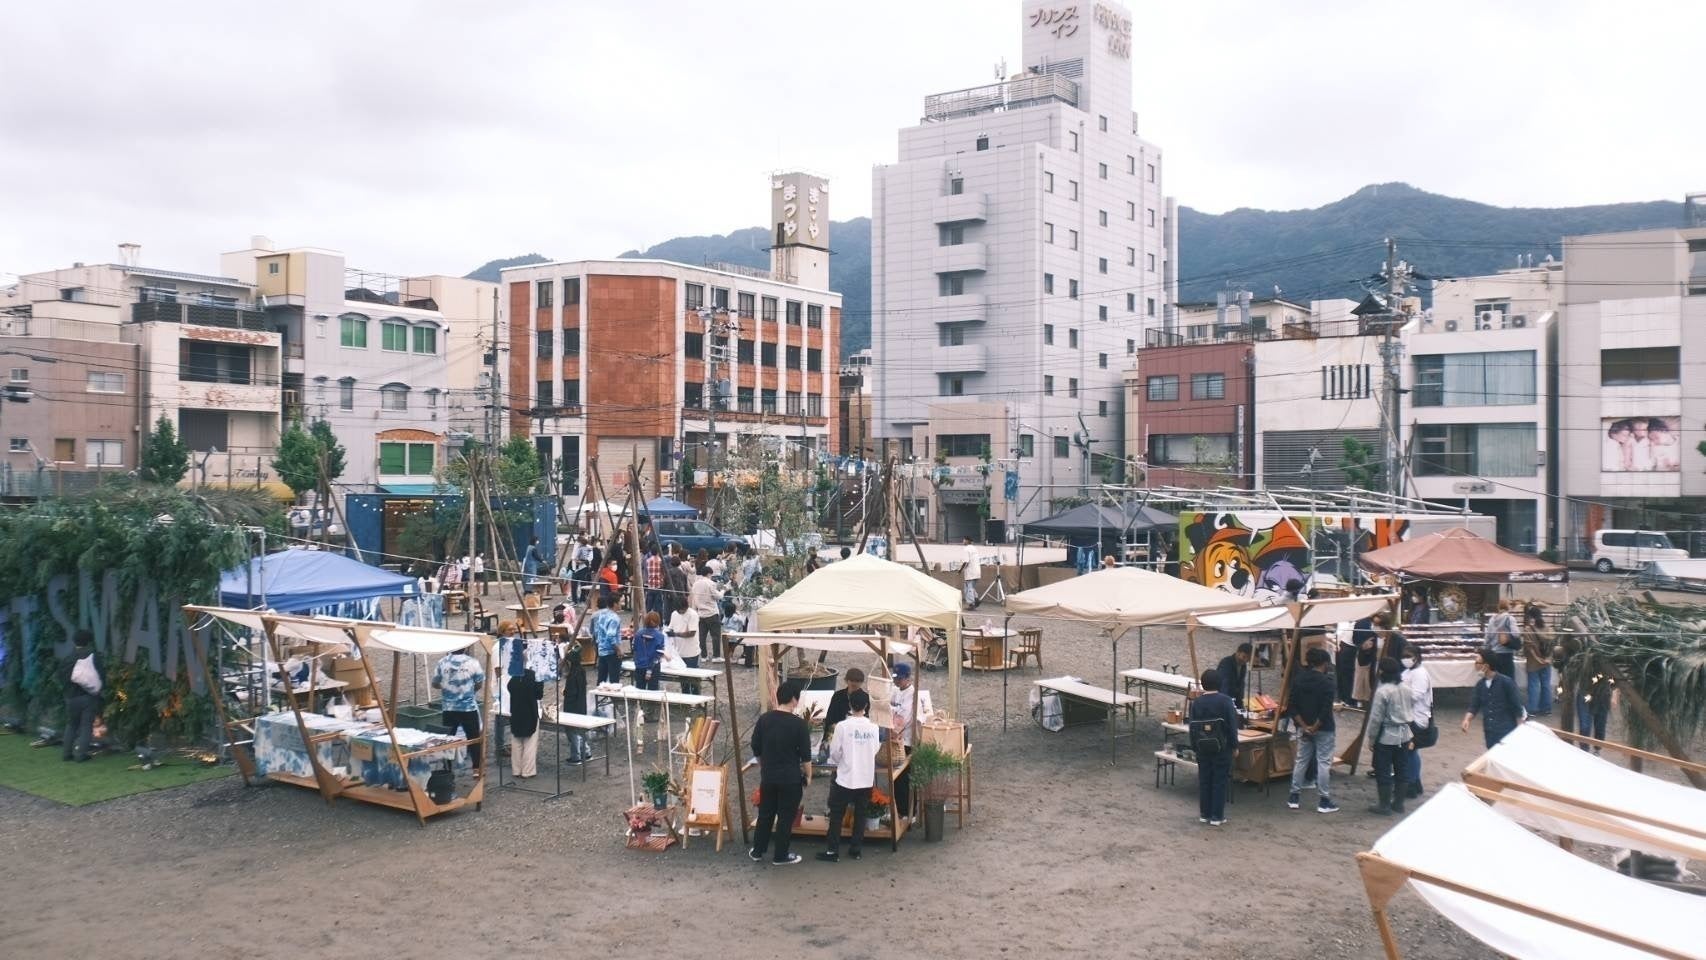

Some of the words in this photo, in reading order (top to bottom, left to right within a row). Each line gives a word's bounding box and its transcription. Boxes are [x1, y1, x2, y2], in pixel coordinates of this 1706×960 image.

[1029, 6, 1079, 27] プリンス
[1051, 24, 1079, 39] イン
[784, 183, 797, 237] まつや
[0, 568, 212, 697] TSMAN
